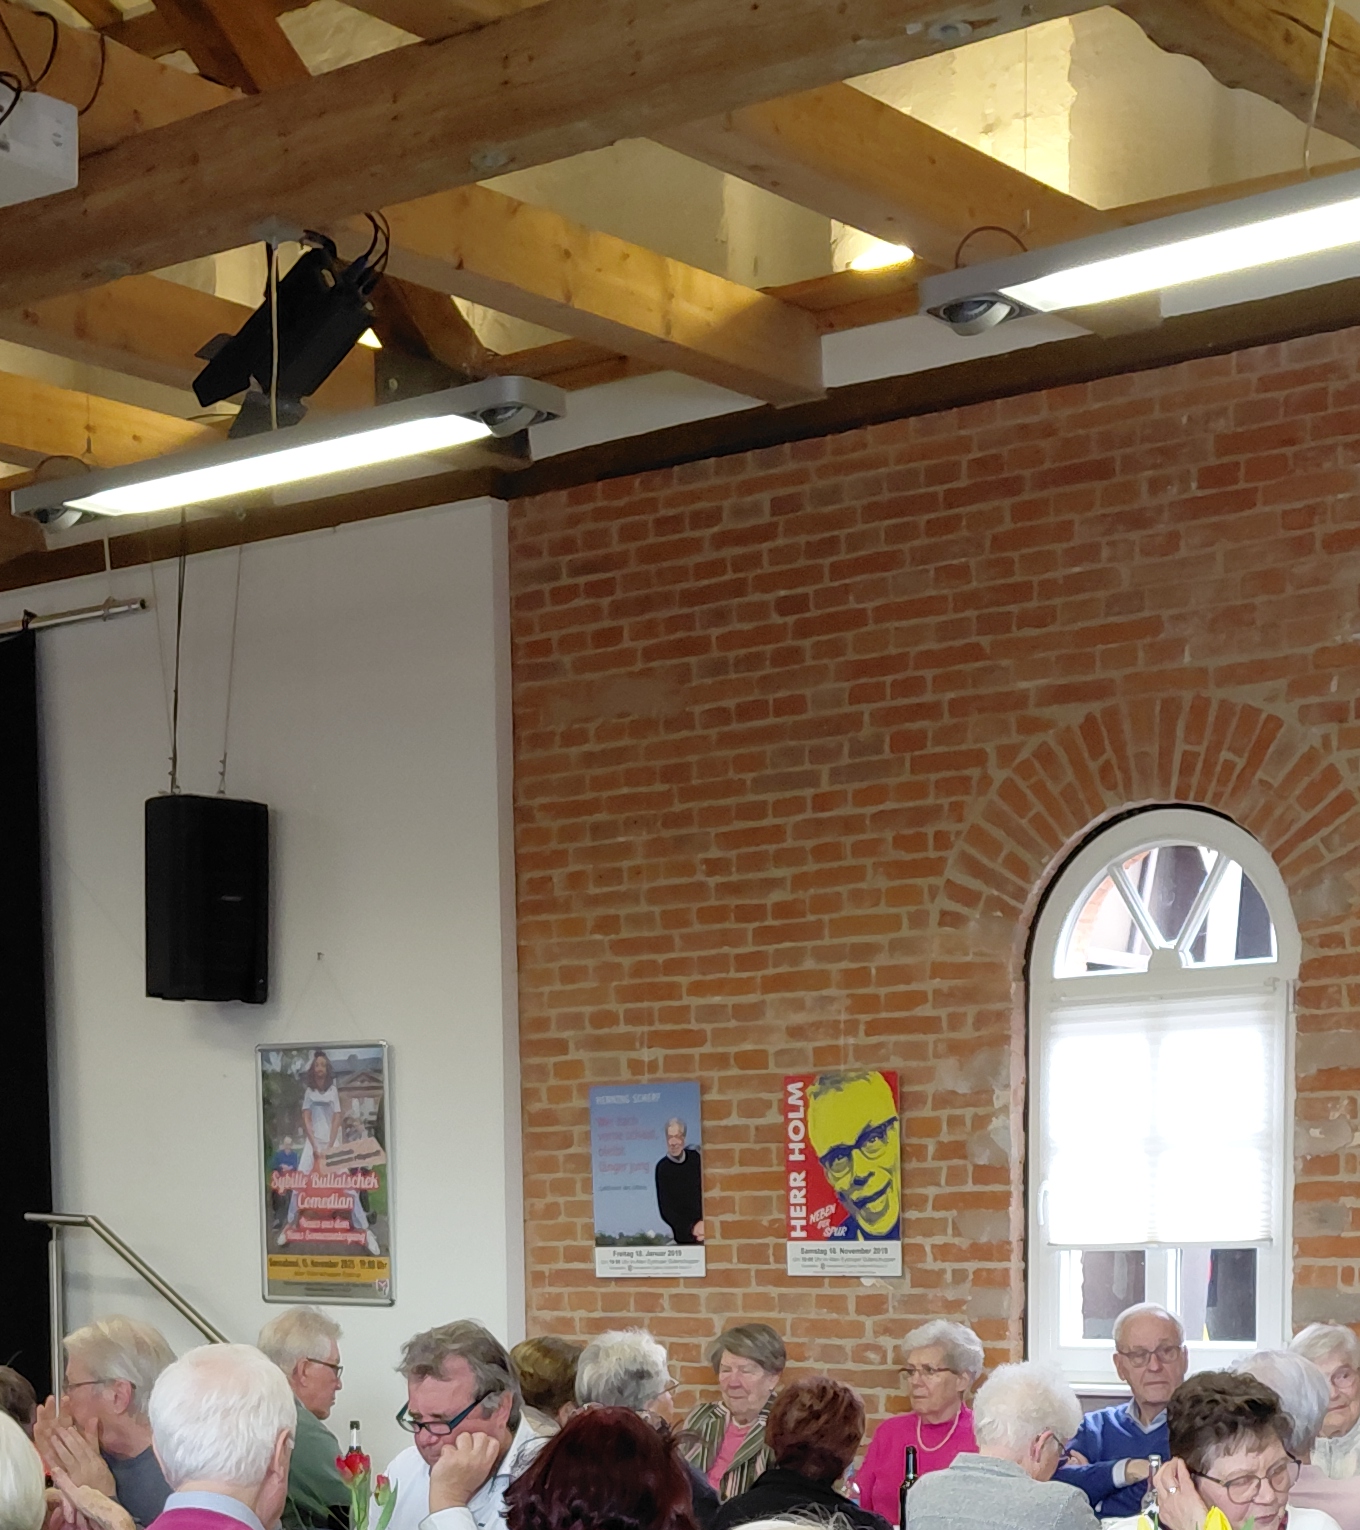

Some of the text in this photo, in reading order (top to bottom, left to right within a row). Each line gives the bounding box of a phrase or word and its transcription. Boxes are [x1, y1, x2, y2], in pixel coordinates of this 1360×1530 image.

[787, 1082, 807, 1238] HERR HOLM
[297, 1192, 354, 1210] Comedian
[809, 1203, 836, 1225] NEBEN
